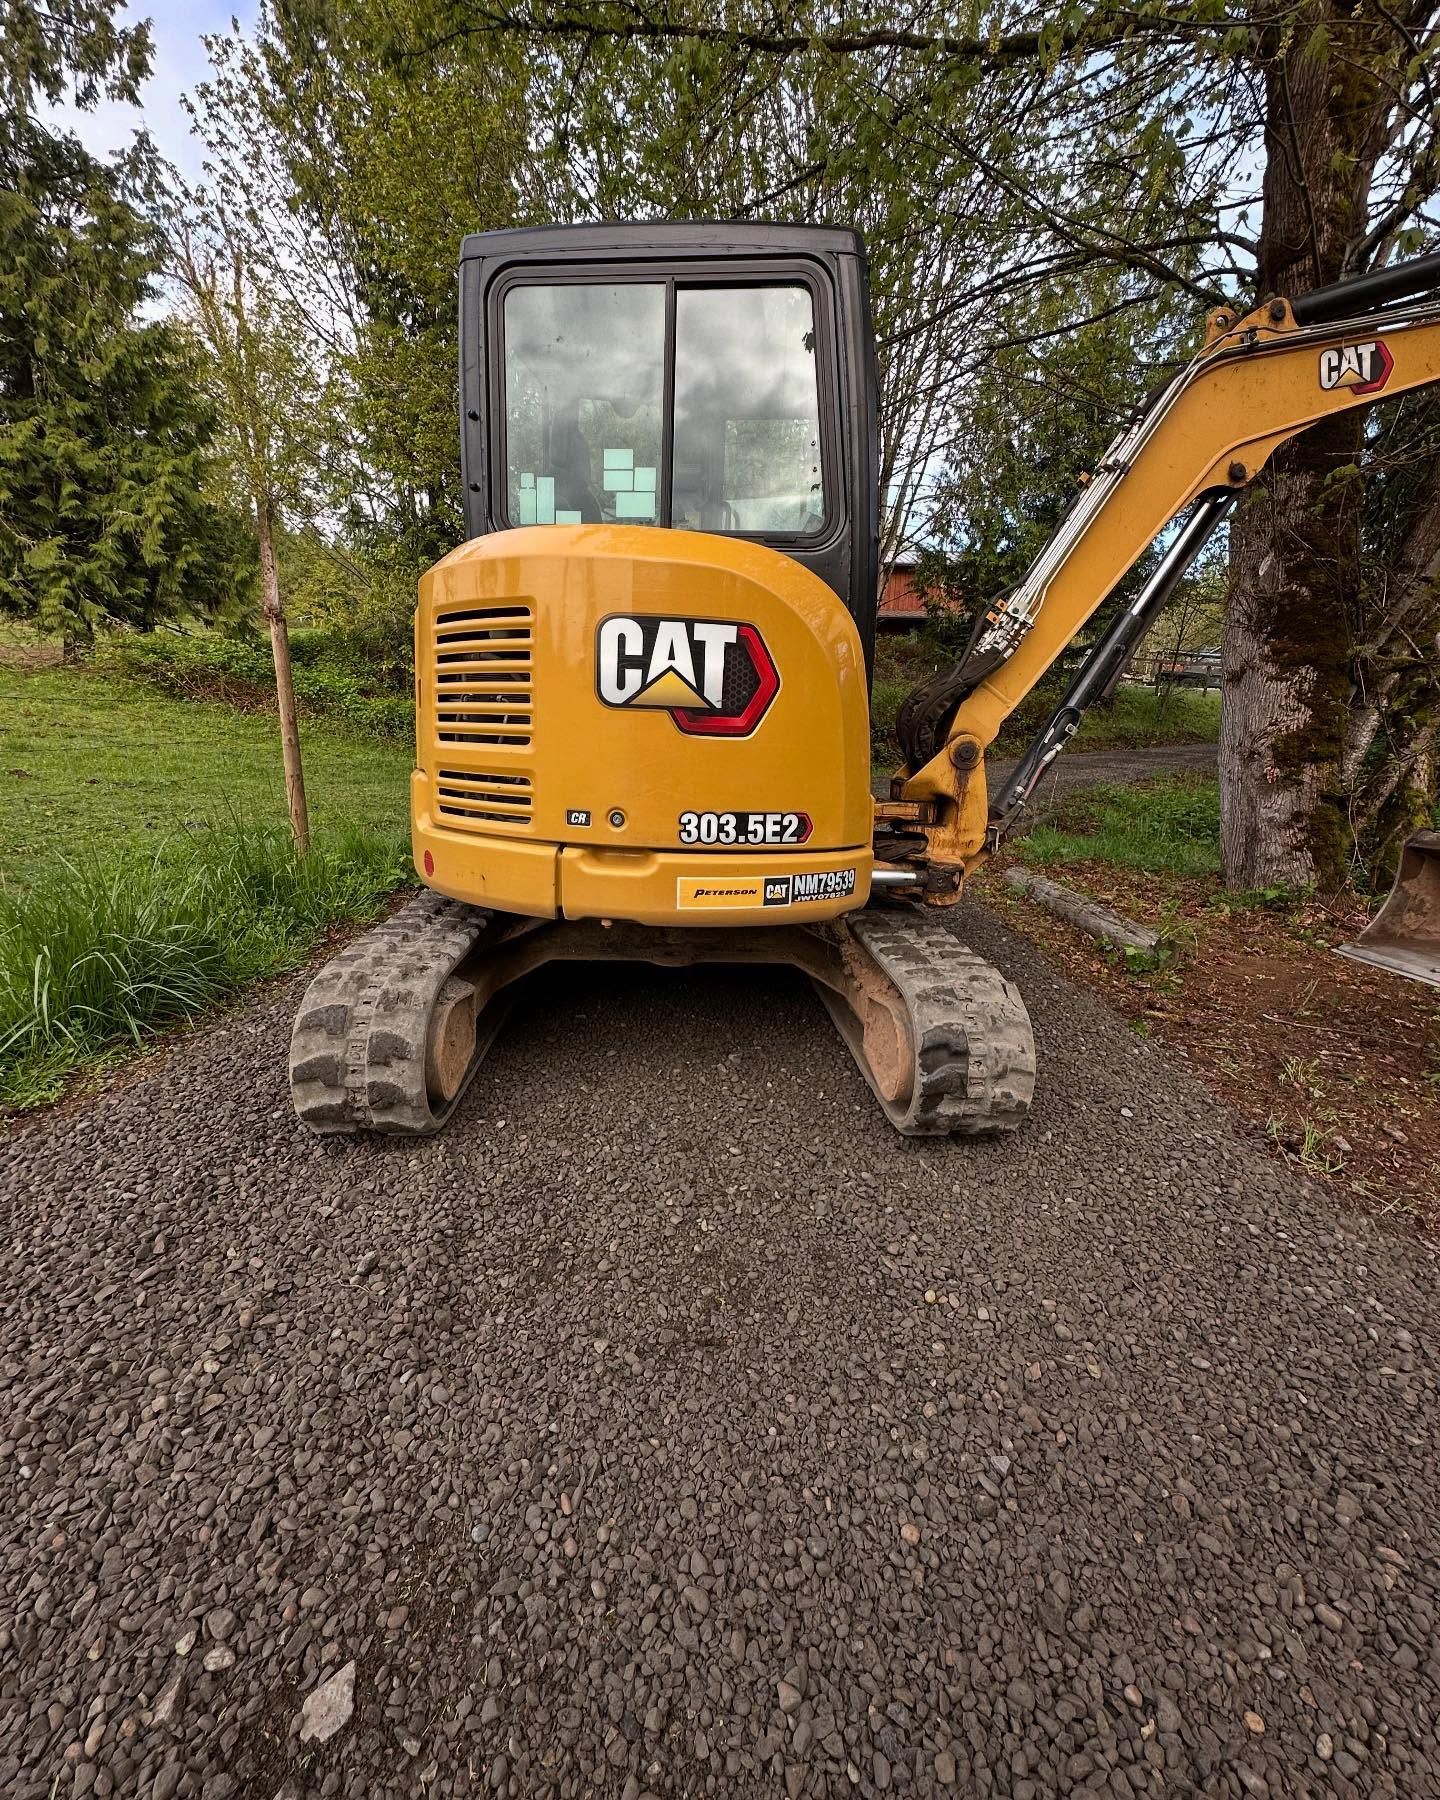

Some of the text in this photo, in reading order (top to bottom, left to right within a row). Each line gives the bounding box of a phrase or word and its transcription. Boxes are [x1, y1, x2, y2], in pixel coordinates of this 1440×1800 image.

[1320, 342, 1376, 389] CAT
[600, 617, 738, 709] CAT
[570, 812, 587, 824] CR
[679, 812, 799, 844] 303.5E2
[694, 884, 788, 899] PETERSON CAT
[794, 869, 855, 895] NM79539
